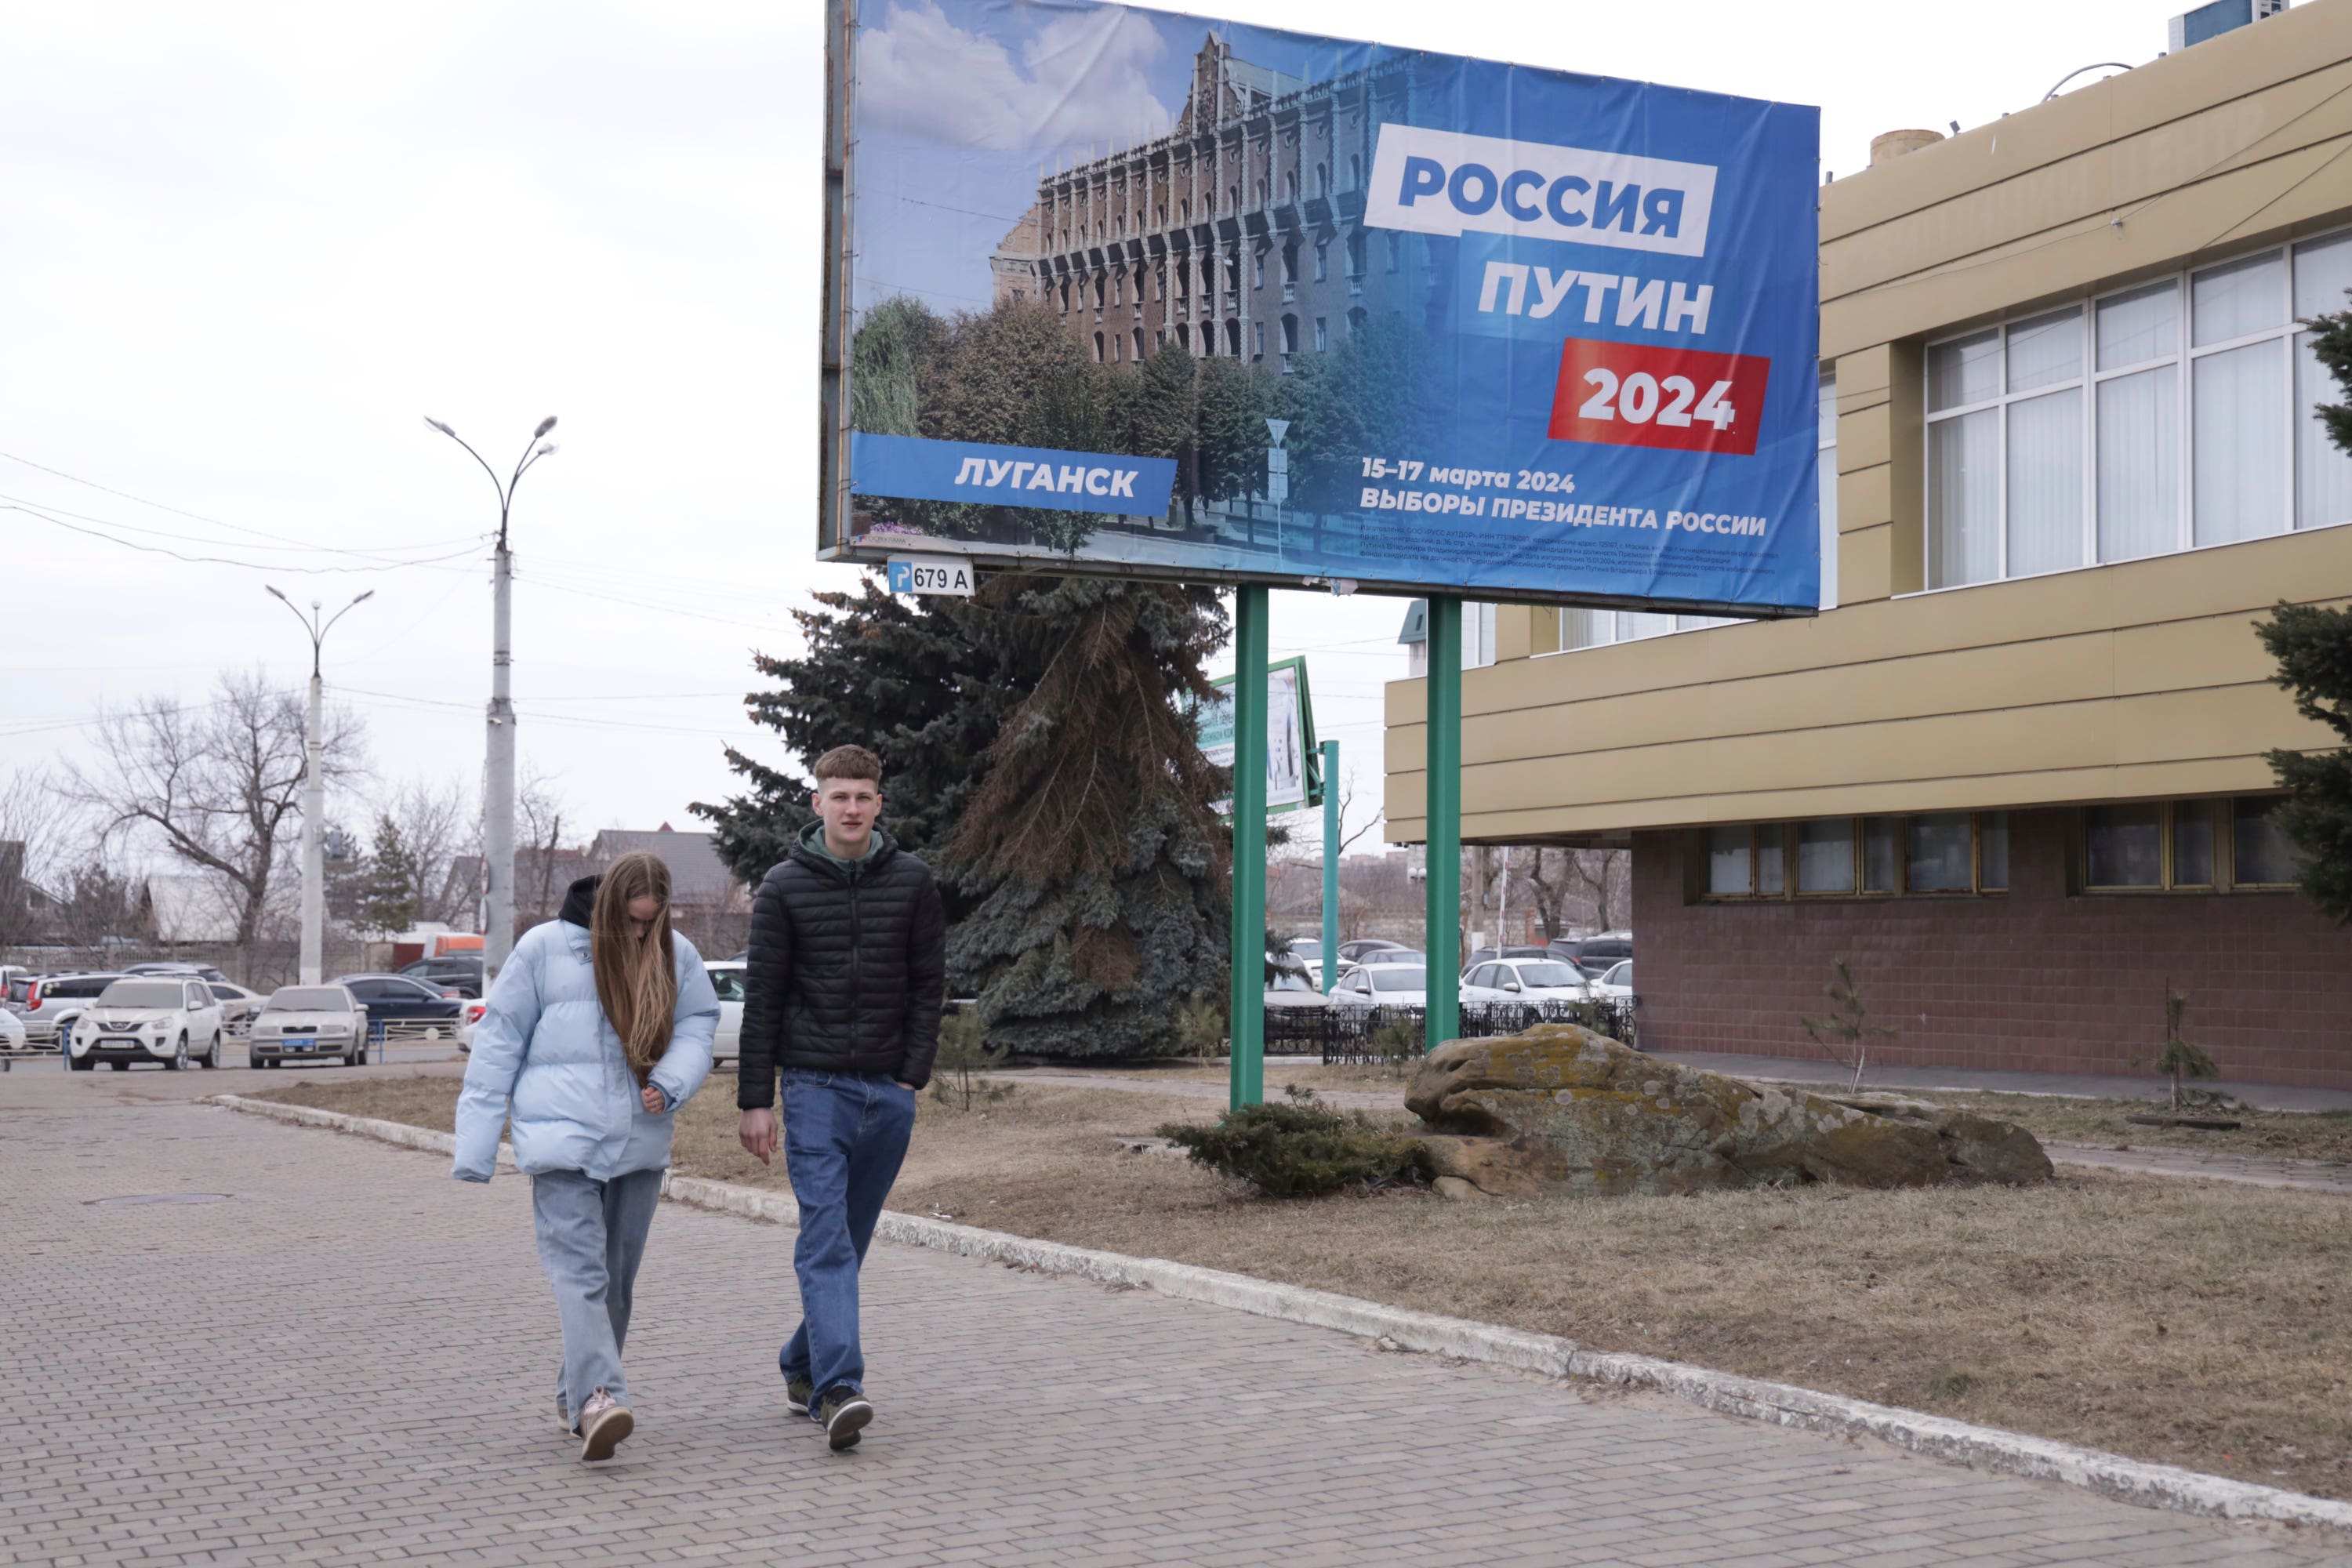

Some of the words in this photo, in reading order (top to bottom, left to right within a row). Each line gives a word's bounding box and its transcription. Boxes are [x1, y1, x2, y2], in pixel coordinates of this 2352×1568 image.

[1399, 155, 1685, 238] РОССИЯ
[1478, 261, 1714, 335] ПУТИН
[1578, 368, 1736, 430] 2024
[955, 457, 1139, 498] ЛУГАНСК
[1429, 466, 1510, 490] марта
[1516, 470, 1575, 494] 2024
[1359, 488, 1485, 517] ВЫБОРЫ
[1492, 498, 1658, 529] ПРЕЗИДЕНТА
[1666, 511, 1767, 536] РОССИИ
[914, 568, 947, 588] 679
